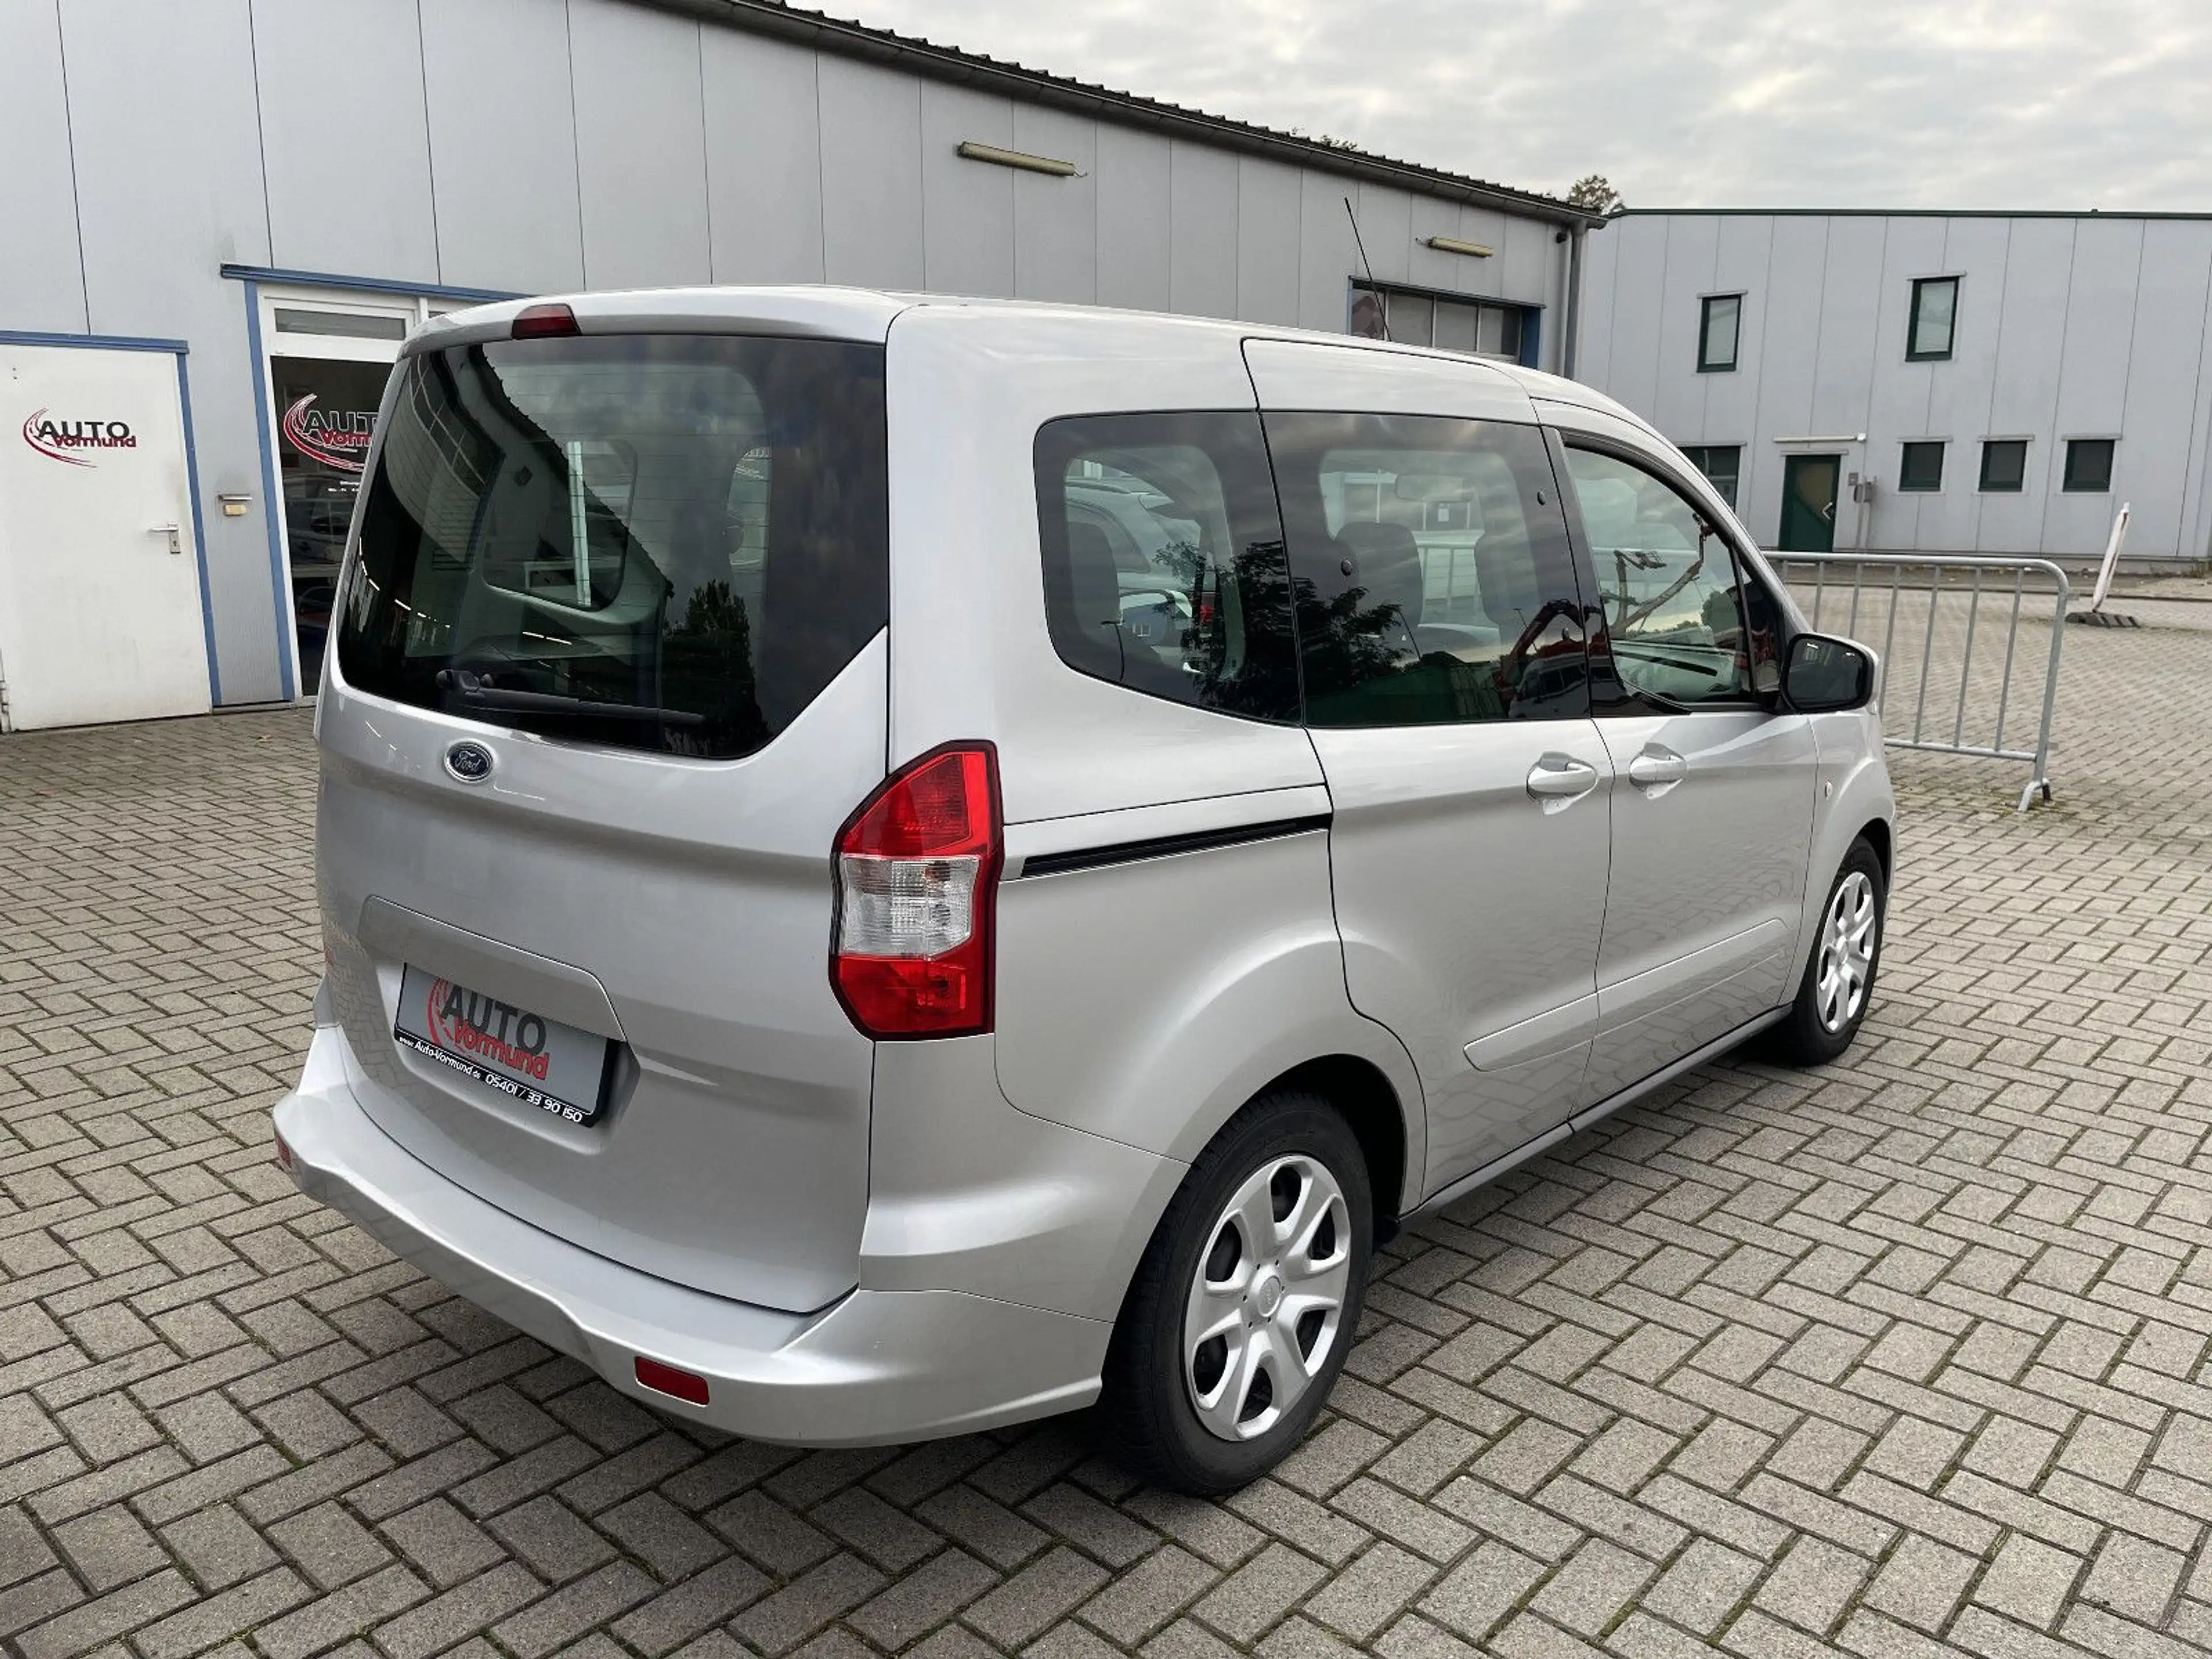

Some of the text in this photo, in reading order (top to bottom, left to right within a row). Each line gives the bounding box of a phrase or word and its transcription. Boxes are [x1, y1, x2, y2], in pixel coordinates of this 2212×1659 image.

[37, 420, 130, 440] AUTO
[301, 410, 379, 435] AUT
[55, 435, 137, 448] Vormund
[320, 429, 373, 447] Vorm
[454, 750, 482, 773] Ford
[440, 984, 547, 1056] AUTO
[454, 1016, 550, 1081] Vormund
[485, 1074, 518, 1096] 05401
[527, 1091, 541, 1105] 33
[543, 1097, 560, 1113] 90
[562, 1106, 583, 1123] 150
